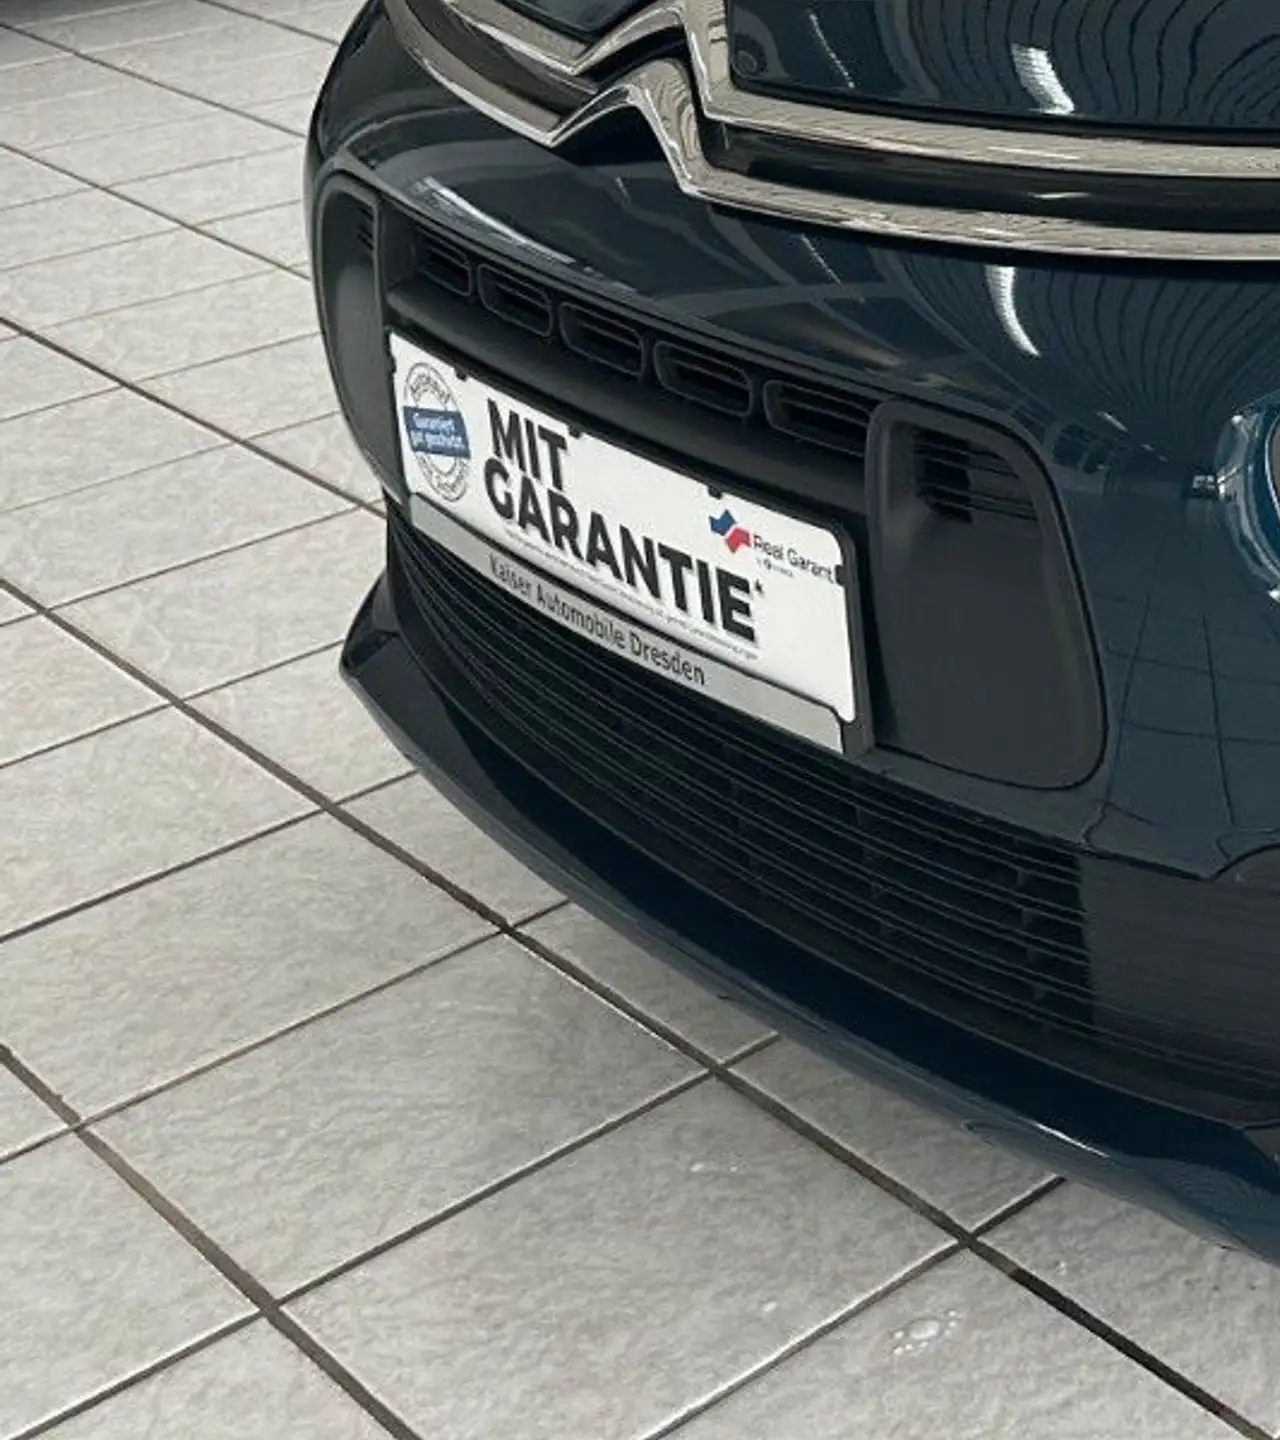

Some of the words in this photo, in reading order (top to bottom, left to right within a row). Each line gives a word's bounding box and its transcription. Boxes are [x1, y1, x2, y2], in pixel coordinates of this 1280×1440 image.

[487, 397, 568, 492] MIT
[753, 533, 784, 561] Real
[489, 553, 531, 596] Kaiser
[536, 582, 626, 650] Automobile
[629, 629, 705, 686] Dresden
